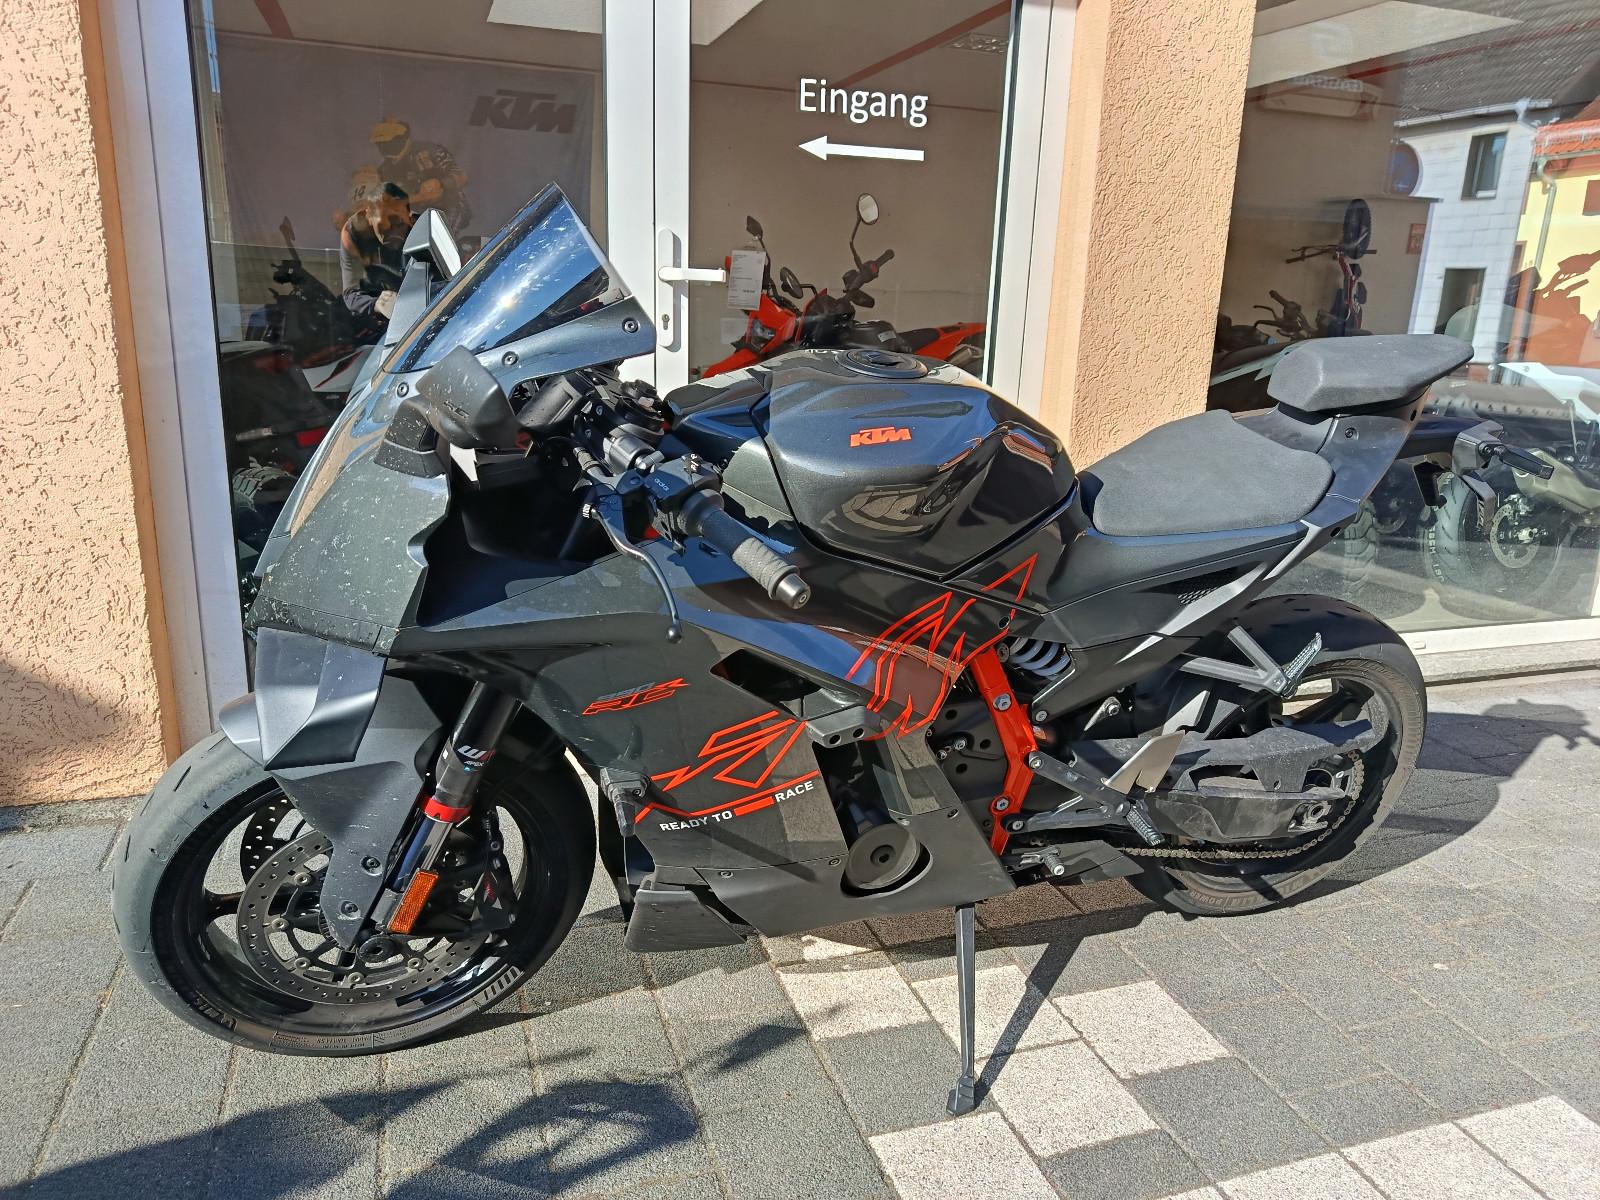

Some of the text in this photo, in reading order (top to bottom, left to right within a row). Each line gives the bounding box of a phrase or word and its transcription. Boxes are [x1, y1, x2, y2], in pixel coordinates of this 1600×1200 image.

[469, 88, 578, 135] KTM
[800, 78, 929, 128] Eingang
[850, 426, 912, 447] KTM
[659, 780, 814, 832] READY TO RACE
